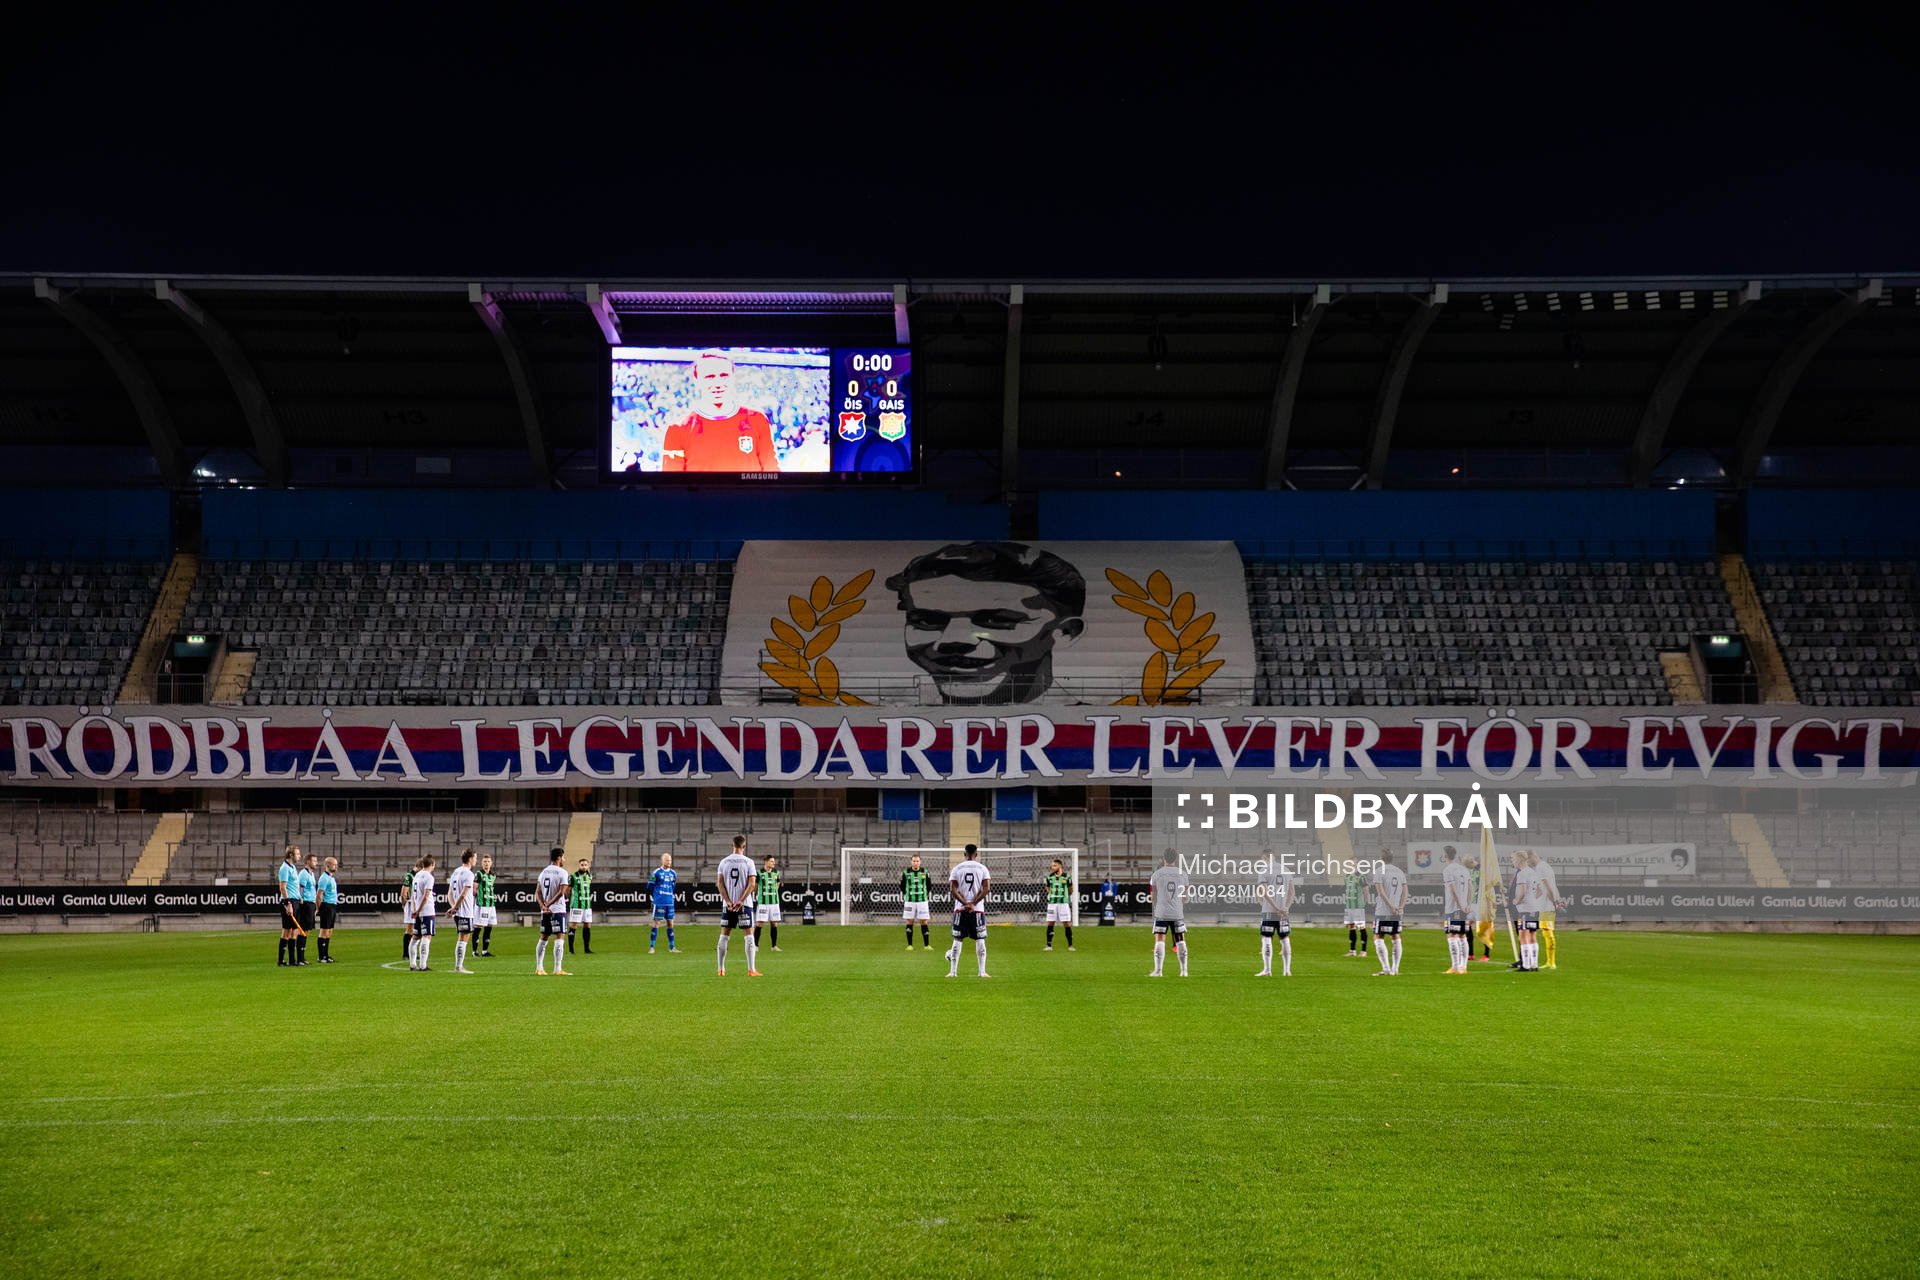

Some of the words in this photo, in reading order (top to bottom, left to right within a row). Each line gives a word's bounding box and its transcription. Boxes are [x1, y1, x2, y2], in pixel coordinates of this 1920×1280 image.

[853, 354, 892, 371] 0:00
[848, 380, 859, 396] 0
[886, 380, 897, 396] 0
[844, 397, 863, 410] ÖIS
[879, 399, 905, 410] GAIS
[1, 705, 429, 782] RÖDBLÅA
[450, 714, 1064, 782] LEGENDARER
[1085, 715, 1387, 780] LEVER
[1413, 707, 1597, 781] FÖR
[1619, 715, 1905, 781] EVIGT
[730, 868, 740, 887] 9
[964, 872, 974, 891] 9
[543, 877, 551, 896] 9
[17, 894, 55, 906] Ullevi
[63, 894, 106, 906] Gamla
[110, 893, 147, 906] Ullevi
[154, 893, 197, 905] Gamla
[200, 893, 237, 905] Ullevi
[336, 893, 378, 904] Gamla
[604, 891, 647, 902] Gamla
[1004, 892, 1040, 903] Ullevi
[1581, 894, 1625, 906] Gamla
[1627, 894, 1665, 907] Ullevi
[1671, 895, 1715, 907] Gamla
[1717, 895, 1755, 907] Ullevi
[1761, 895, 1806, 907] Gamla
[1808, 896, 1847, 908] Ullevi
[1853, 896, 1898, 908] Gamla
